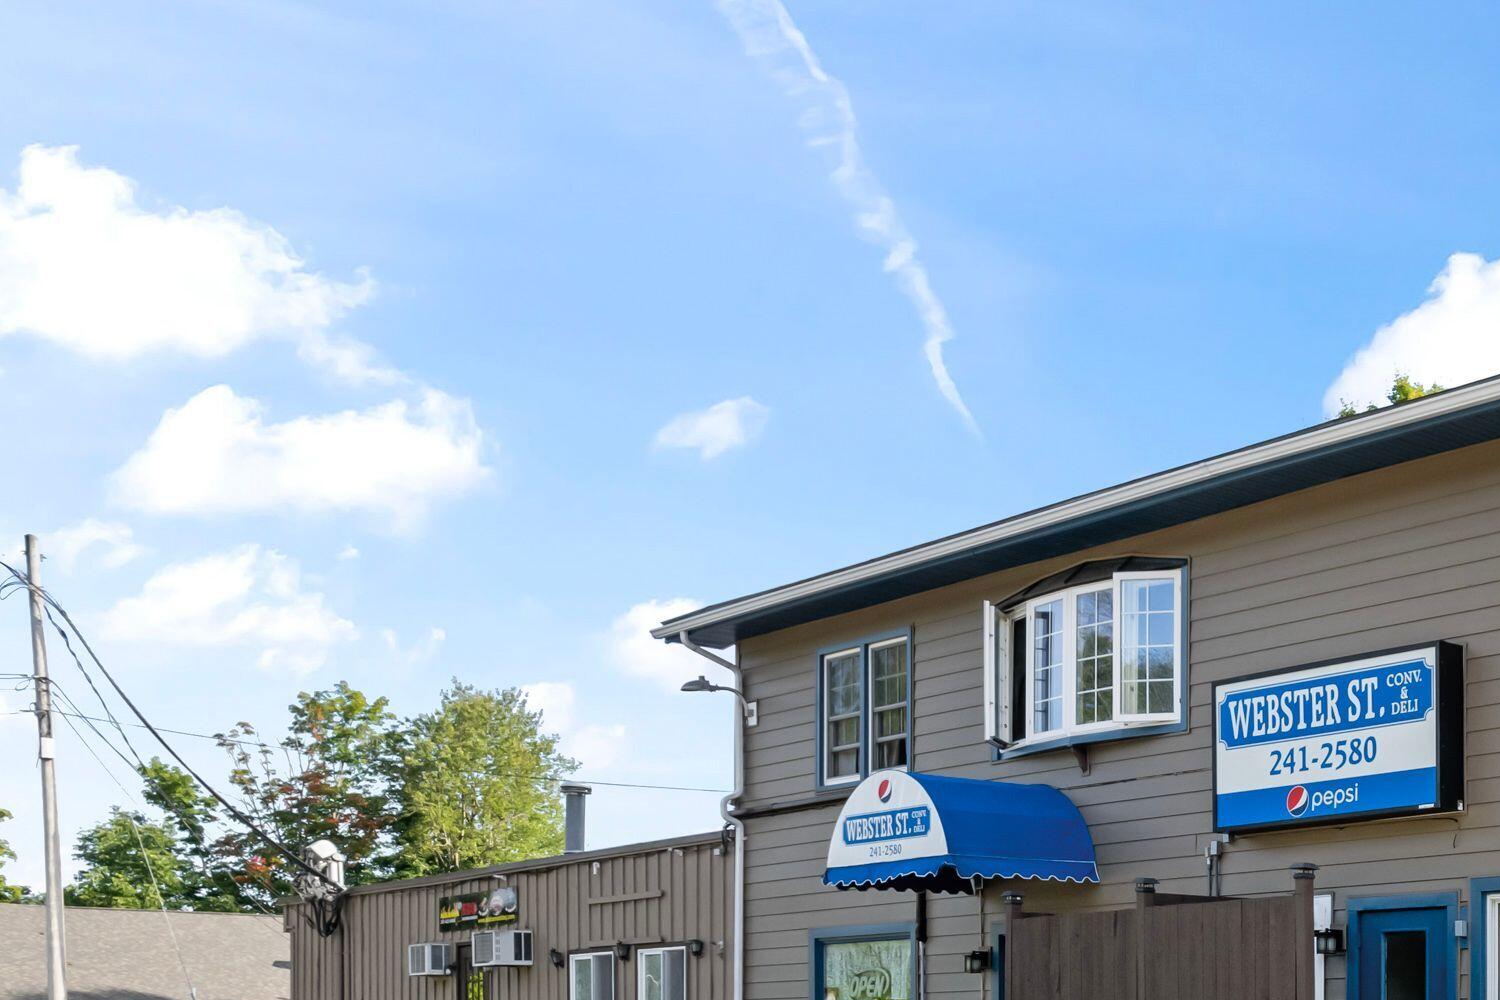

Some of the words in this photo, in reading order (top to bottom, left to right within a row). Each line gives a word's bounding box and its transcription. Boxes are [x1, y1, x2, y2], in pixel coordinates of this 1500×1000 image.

[1386, 669, 1422, 687] CONV.
[1399, 686, 1409, 699] &
[1228, 683, 1341, 740] WEBSTER
[1347, 676, 1385, 722] ST.
[1391, 698, 1419, 716] DELI
[1269, 735, 1377, 776] 241-2580
[1311, 782, 1360, 811] pepsi
[846, 814, 894, 842] WEBSTER
[895, 812, 912, 836] ST.
[869, 843, 902, 857] 241-2580
[849, 975, 885, 998] OPEN
